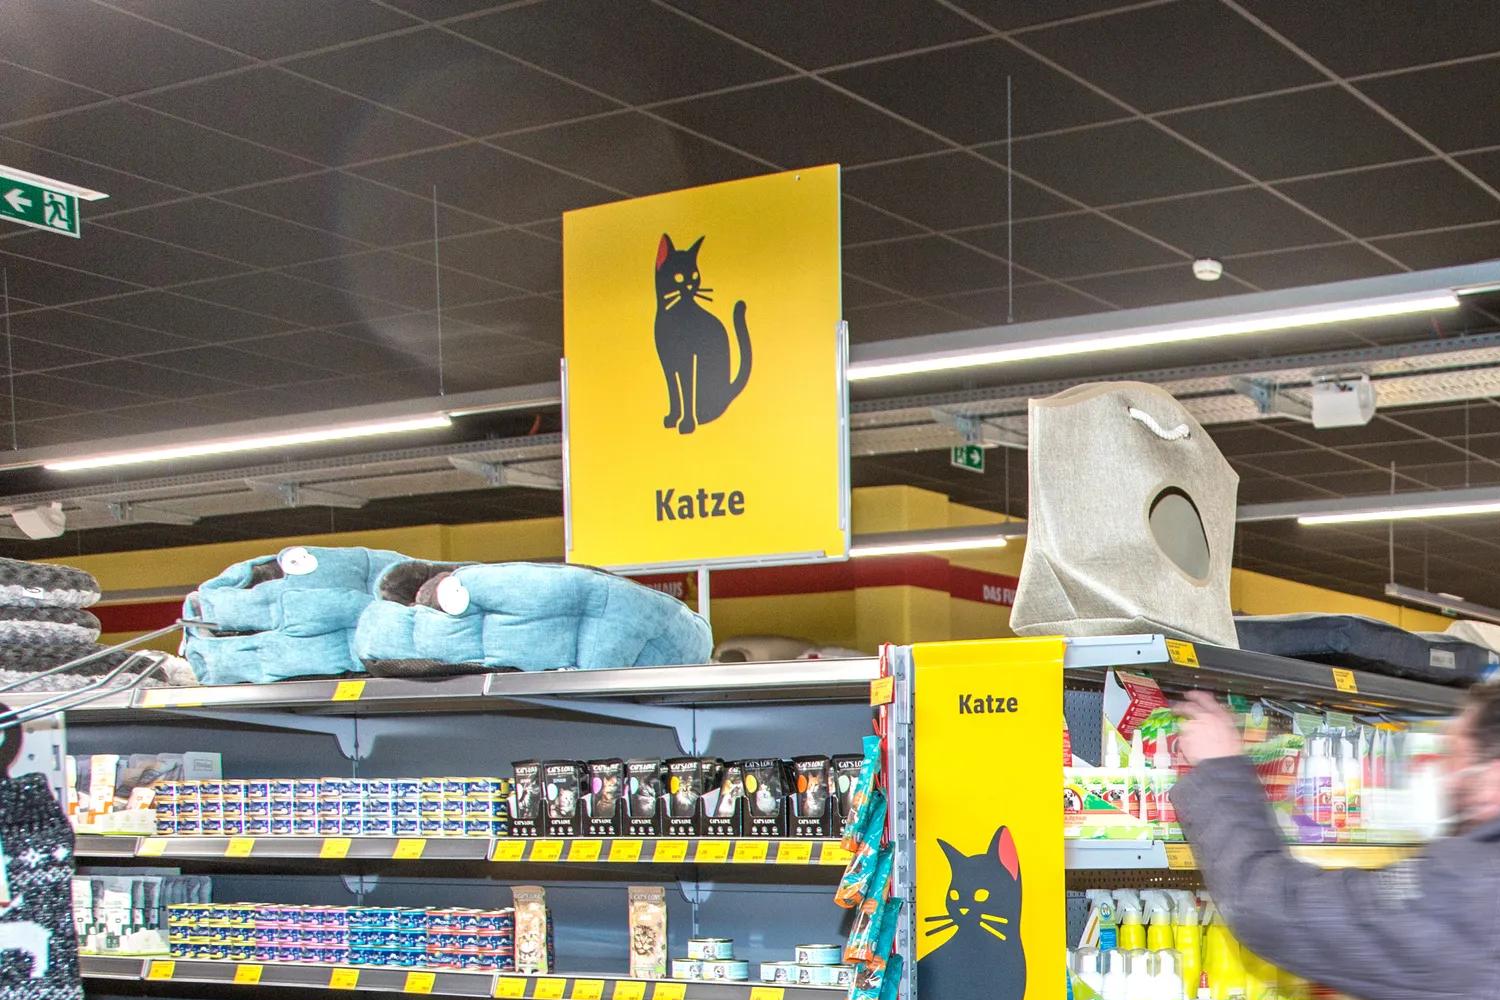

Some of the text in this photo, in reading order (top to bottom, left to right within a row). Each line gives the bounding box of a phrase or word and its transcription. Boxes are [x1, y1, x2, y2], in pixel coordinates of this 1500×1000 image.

[655, 485, 745, 522] Katze
[982, 584, 1001, 602] DAS
[958, 693, 1019, 715] Katze
